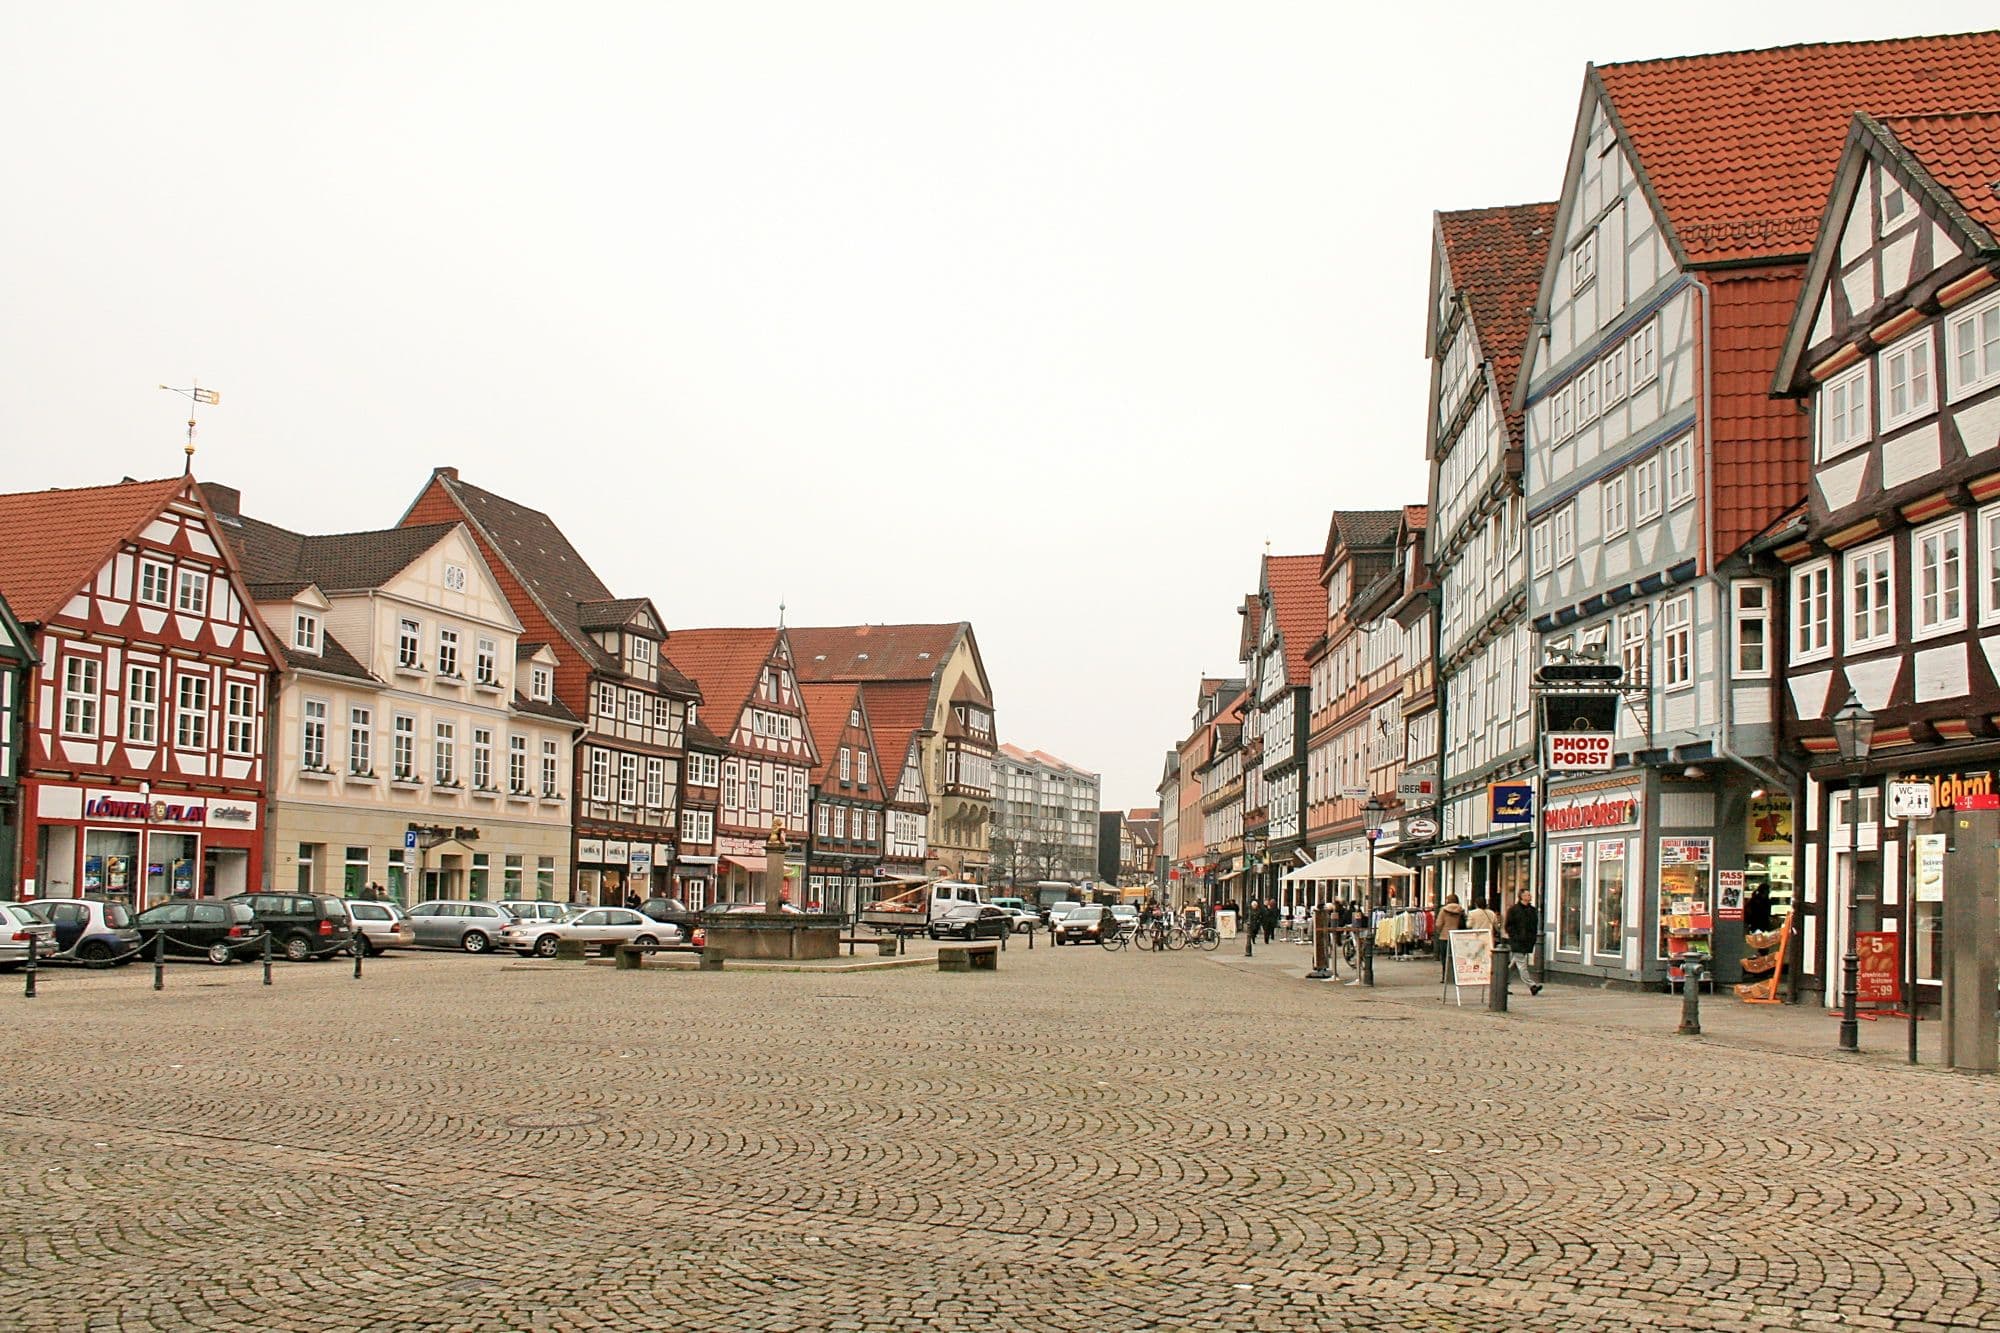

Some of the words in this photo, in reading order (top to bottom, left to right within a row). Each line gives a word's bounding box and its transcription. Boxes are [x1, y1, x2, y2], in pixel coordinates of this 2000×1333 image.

[1553, 738, 1609, 750] PHOTO
[1553, 752, 1608, 765] PORST
[1899, 787, 1913, 795] WC
[86, 795, 150, 820] LÖWEN
[166, 804, 209, 821] PLAY
[1544, 806, 1583, 832] PHOTO
[1583, 800, 1625, 827] PORST
[407, 833, 414, 845] P
[1720, 871, 1742, 880] PASS
[1871, 937, 1883, 953] 5
